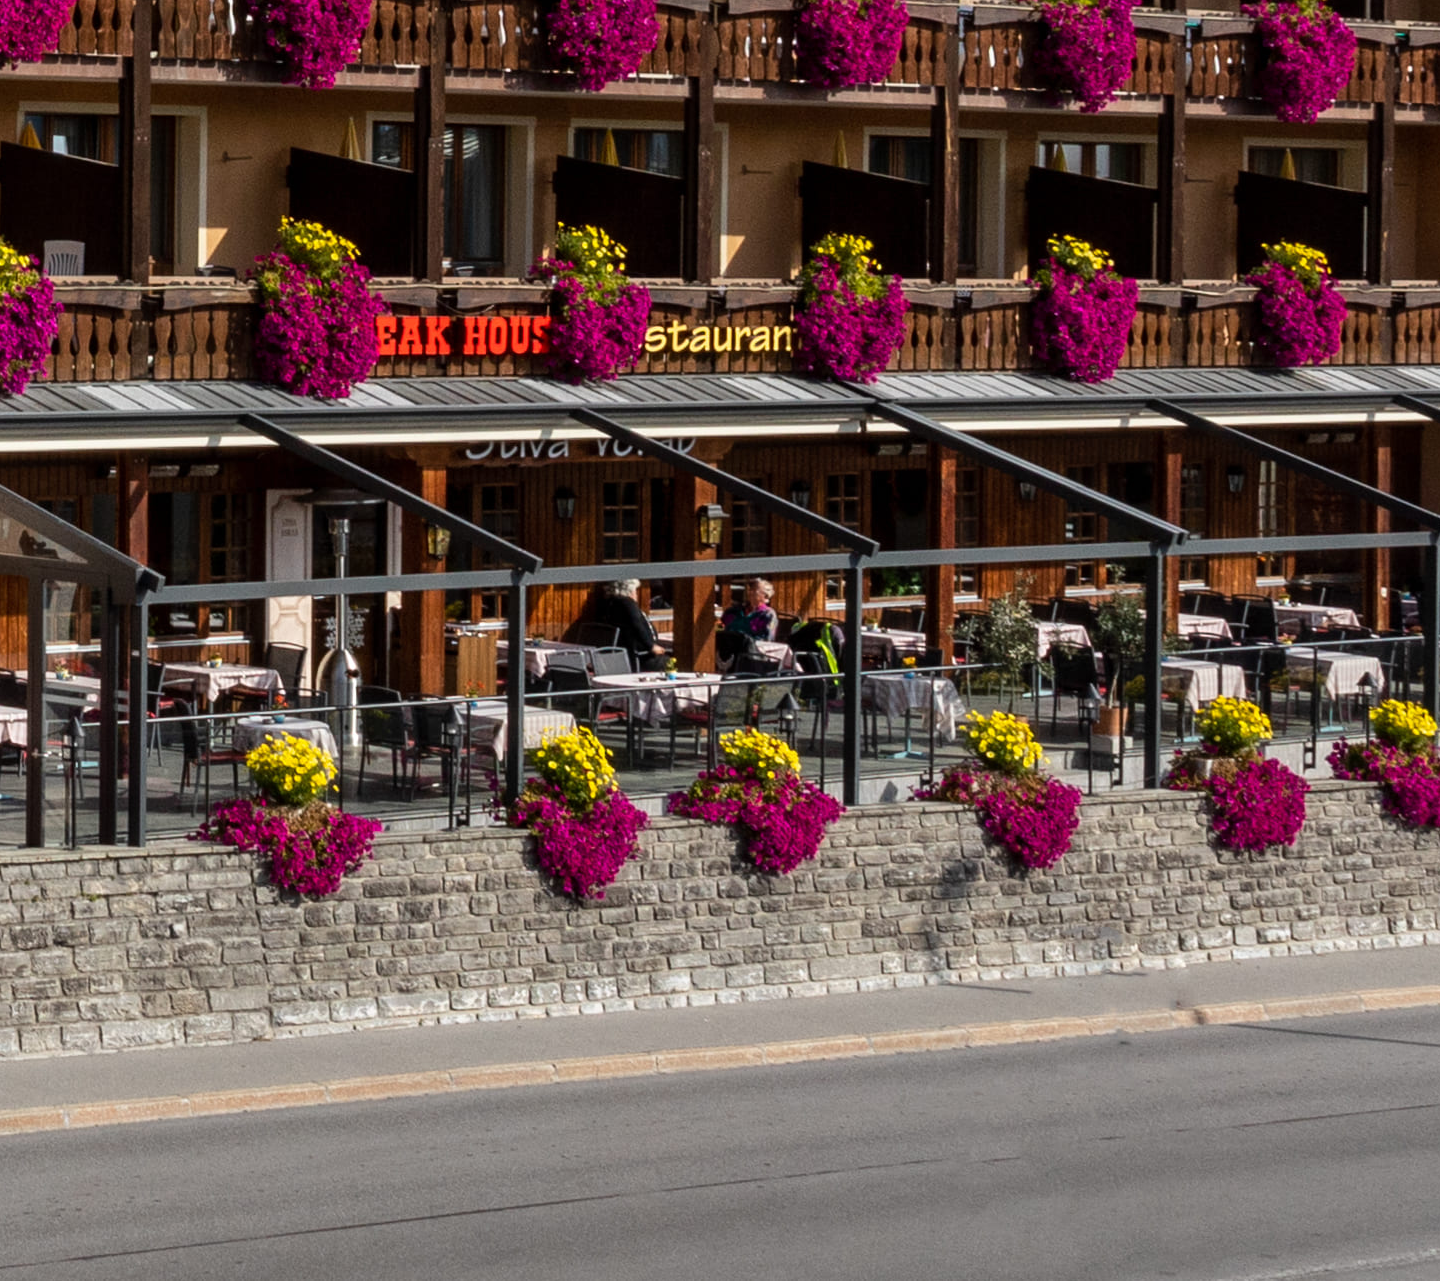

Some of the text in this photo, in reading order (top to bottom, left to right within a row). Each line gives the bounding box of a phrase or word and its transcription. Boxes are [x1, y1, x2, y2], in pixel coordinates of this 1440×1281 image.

[375, 315, 552, 356] EAK HOUS
[644, 319, 794, 353] stauran
